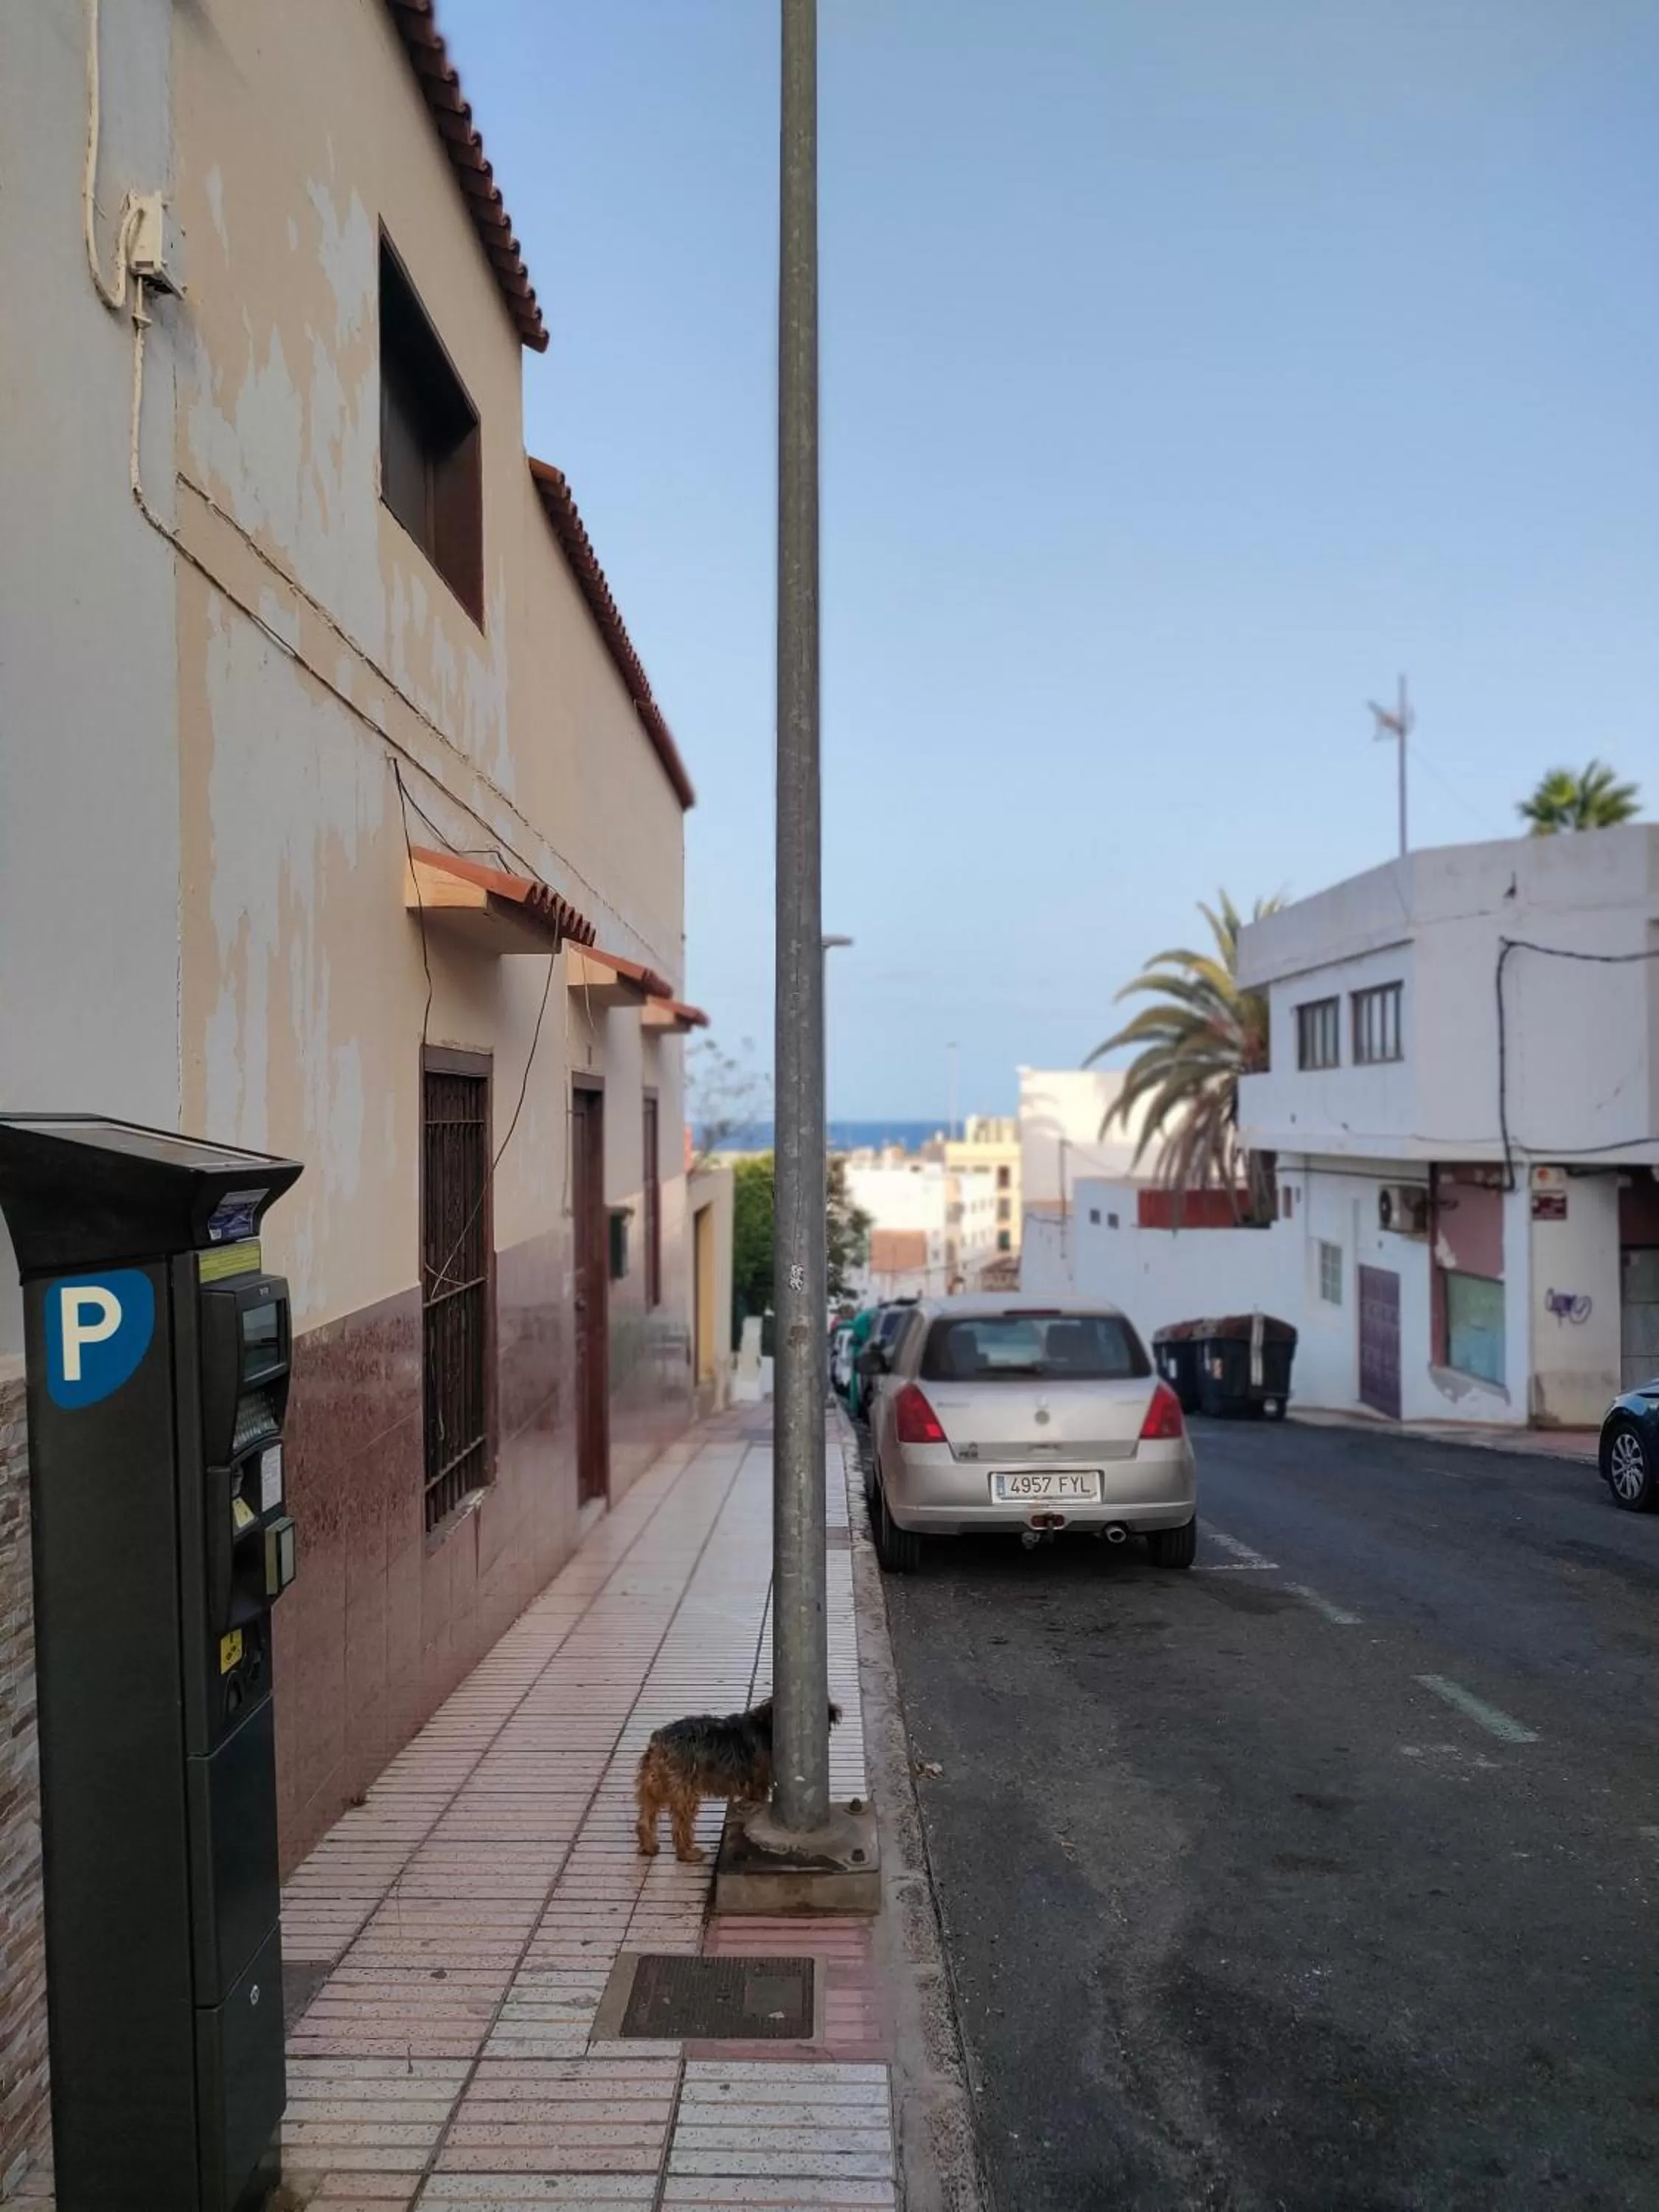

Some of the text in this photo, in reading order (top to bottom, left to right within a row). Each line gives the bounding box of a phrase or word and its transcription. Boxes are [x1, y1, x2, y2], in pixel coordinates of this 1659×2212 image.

[60, 1285, 122, 1381] P
[1010, 1476, 1091, 1493] 4957 FYL
